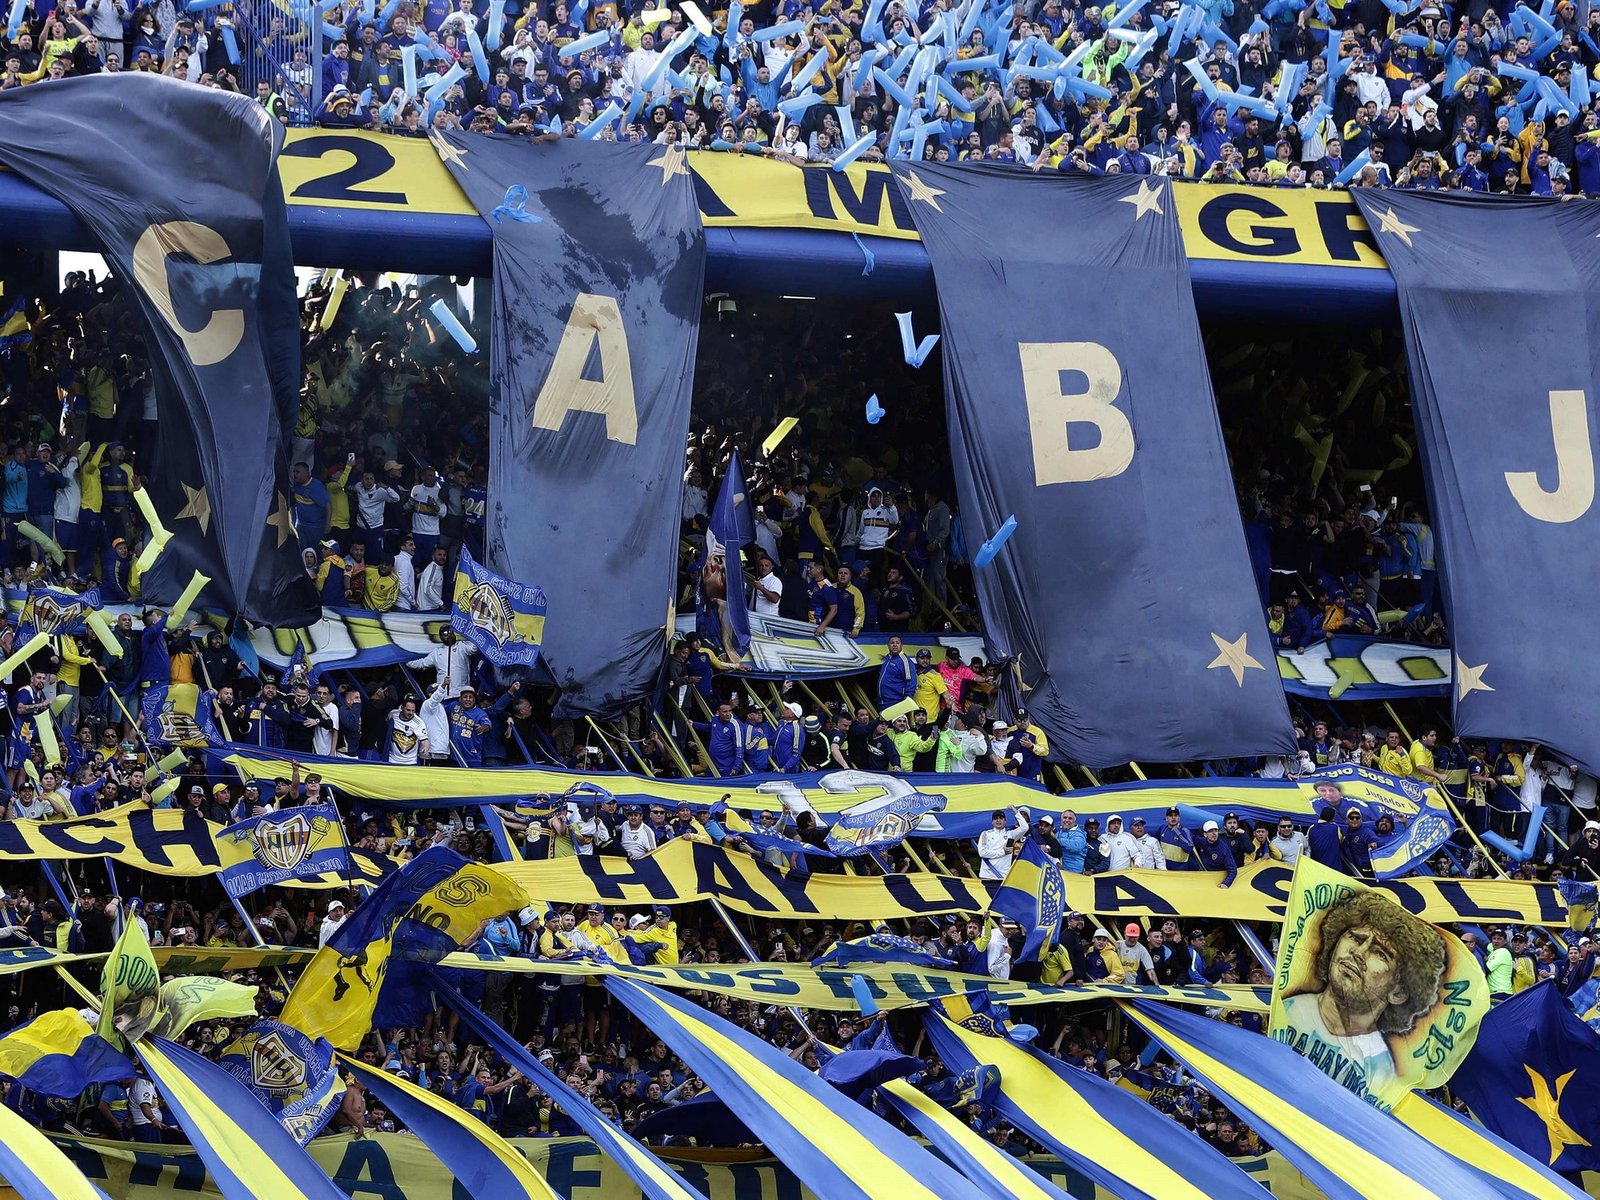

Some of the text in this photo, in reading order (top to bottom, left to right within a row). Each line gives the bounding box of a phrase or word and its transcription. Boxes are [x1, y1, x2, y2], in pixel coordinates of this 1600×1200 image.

[133, 220, 1596, 524] C A B J
[1357, 768, 1395, 788] Sosa
[1365, 787, 1406, 809] Jugador
[577, 841, 820, 914] HAY
[883, 874, 1181, 915] UA
